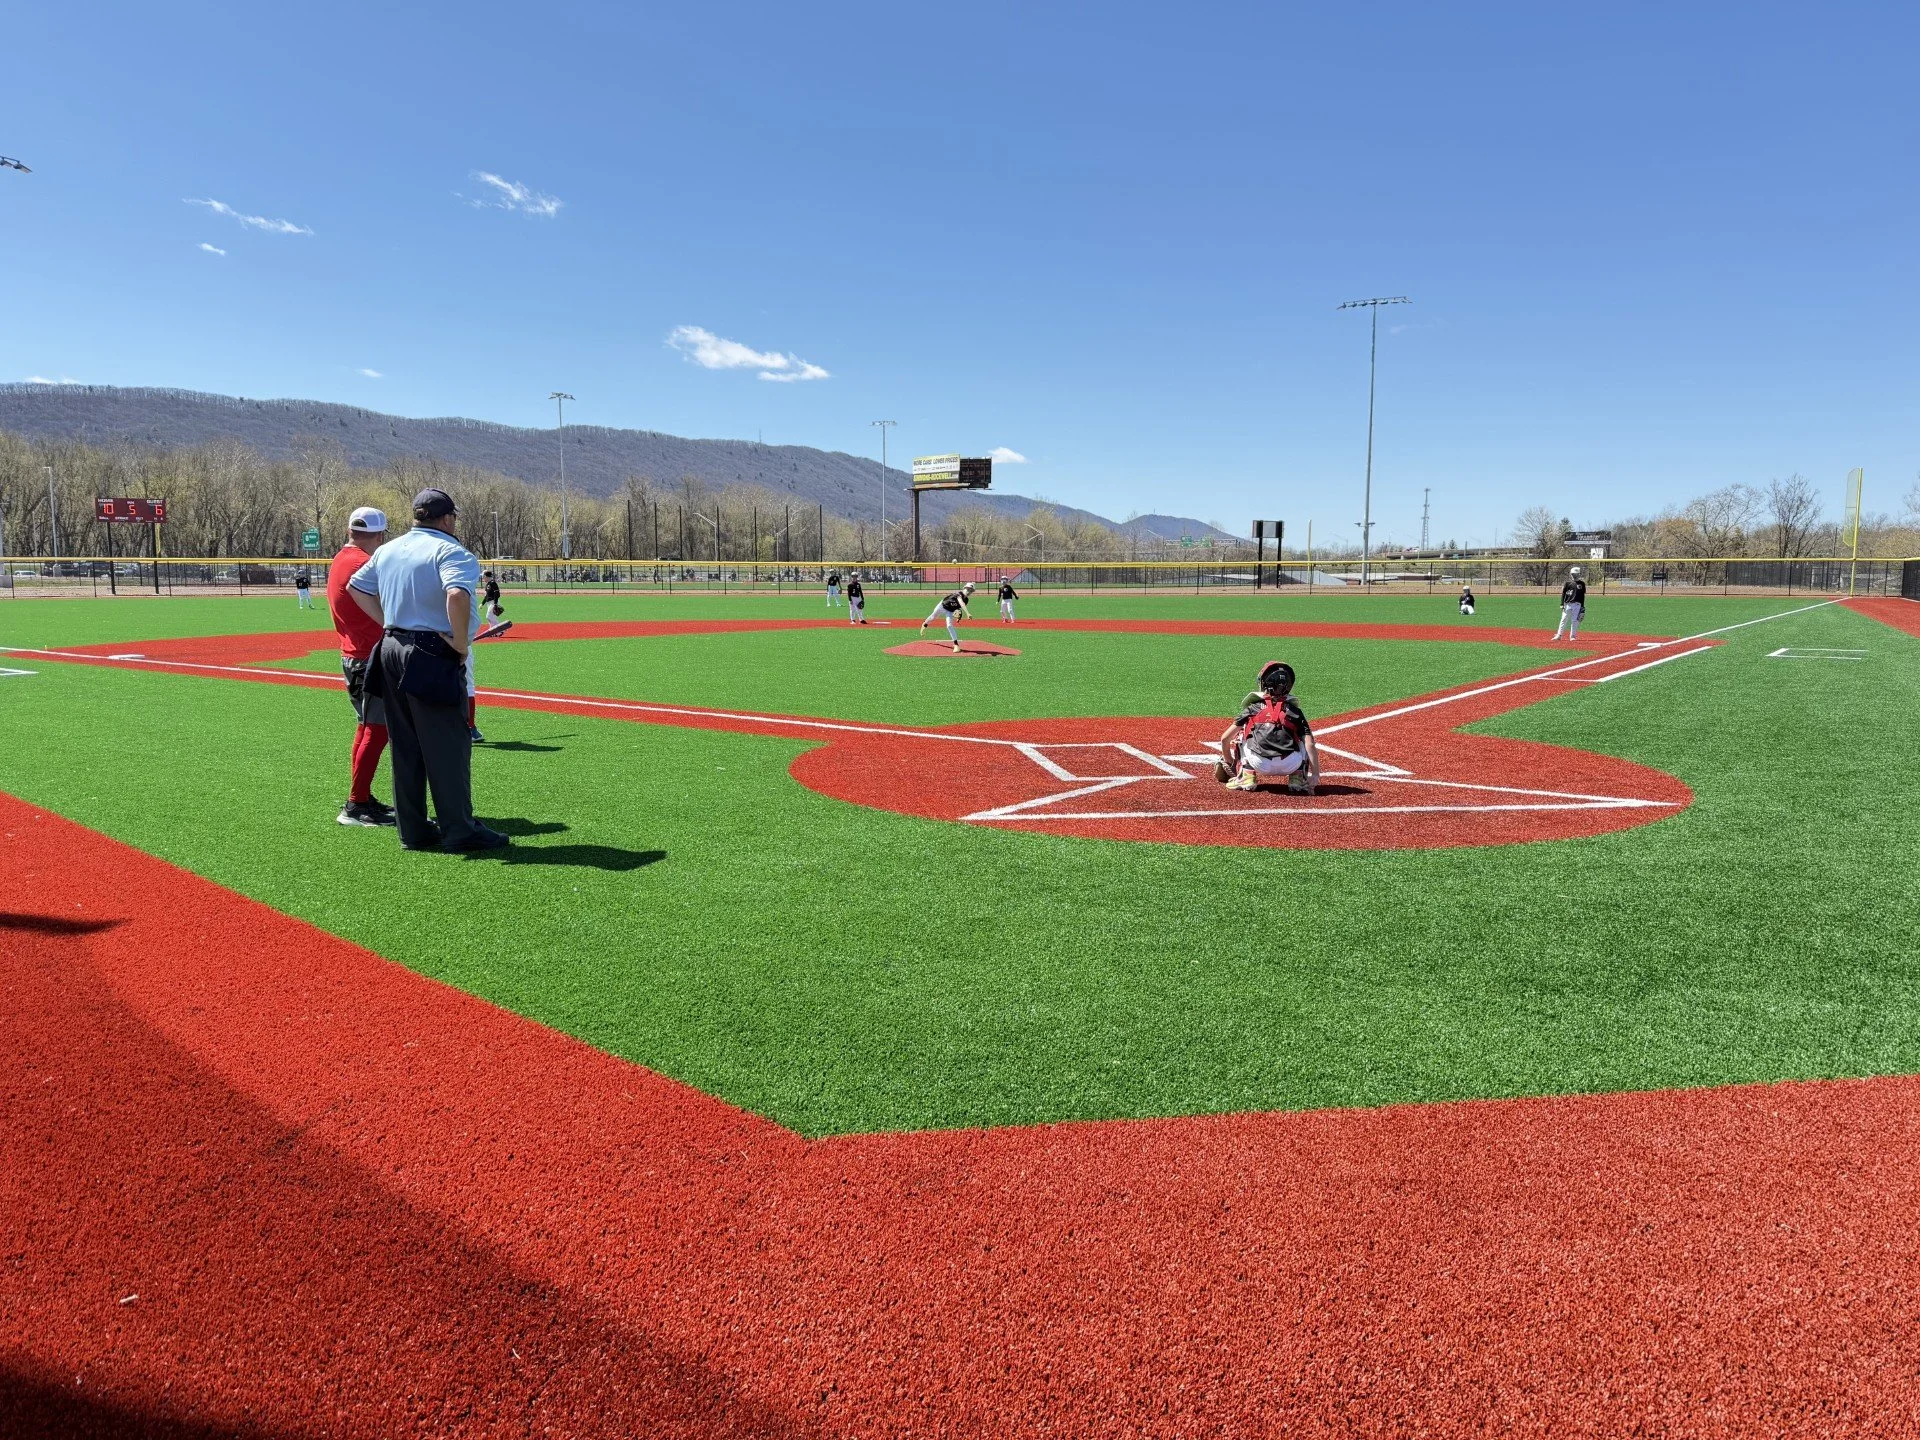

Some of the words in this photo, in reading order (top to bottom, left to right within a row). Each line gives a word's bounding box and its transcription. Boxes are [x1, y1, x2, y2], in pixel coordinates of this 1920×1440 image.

[104, 503, 114, 514] 10
[129, 504, 136, 514] 5
[155, 504, 163, 515] 6
